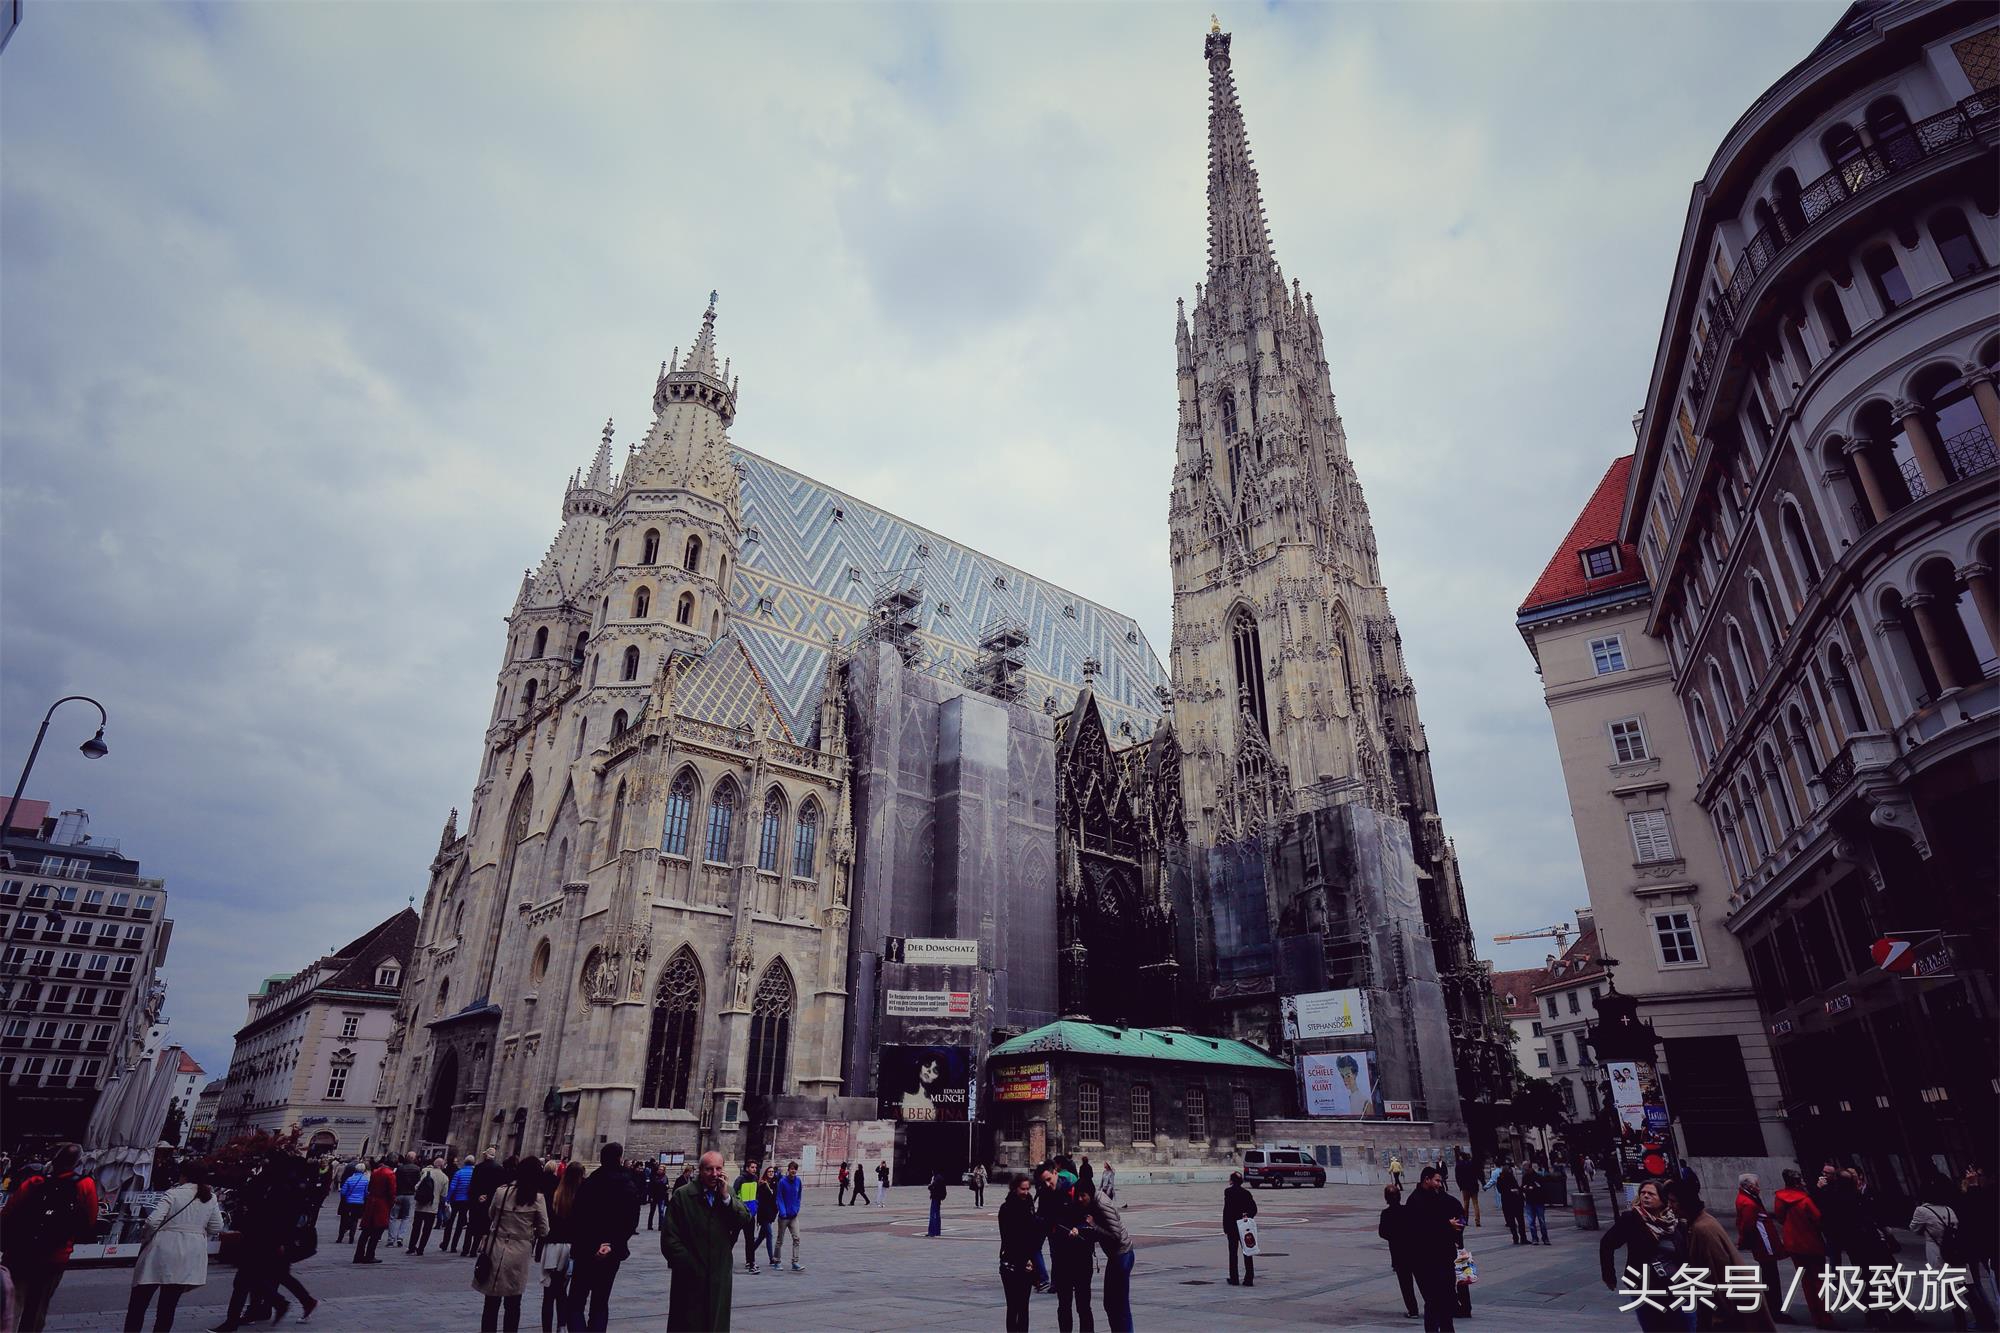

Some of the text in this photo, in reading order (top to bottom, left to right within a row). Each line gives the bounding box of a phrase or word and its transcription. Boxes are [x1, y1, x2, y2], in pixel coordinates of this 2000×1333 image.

[926, 944, 975, 953] DOMSCHATZ
[1308, 1021, 1353, 1031] STEPHANSDOM
[1308, 1068, 1334, 1077] SCHIELE
[931, 1094, 965, 1103] MUNCH
